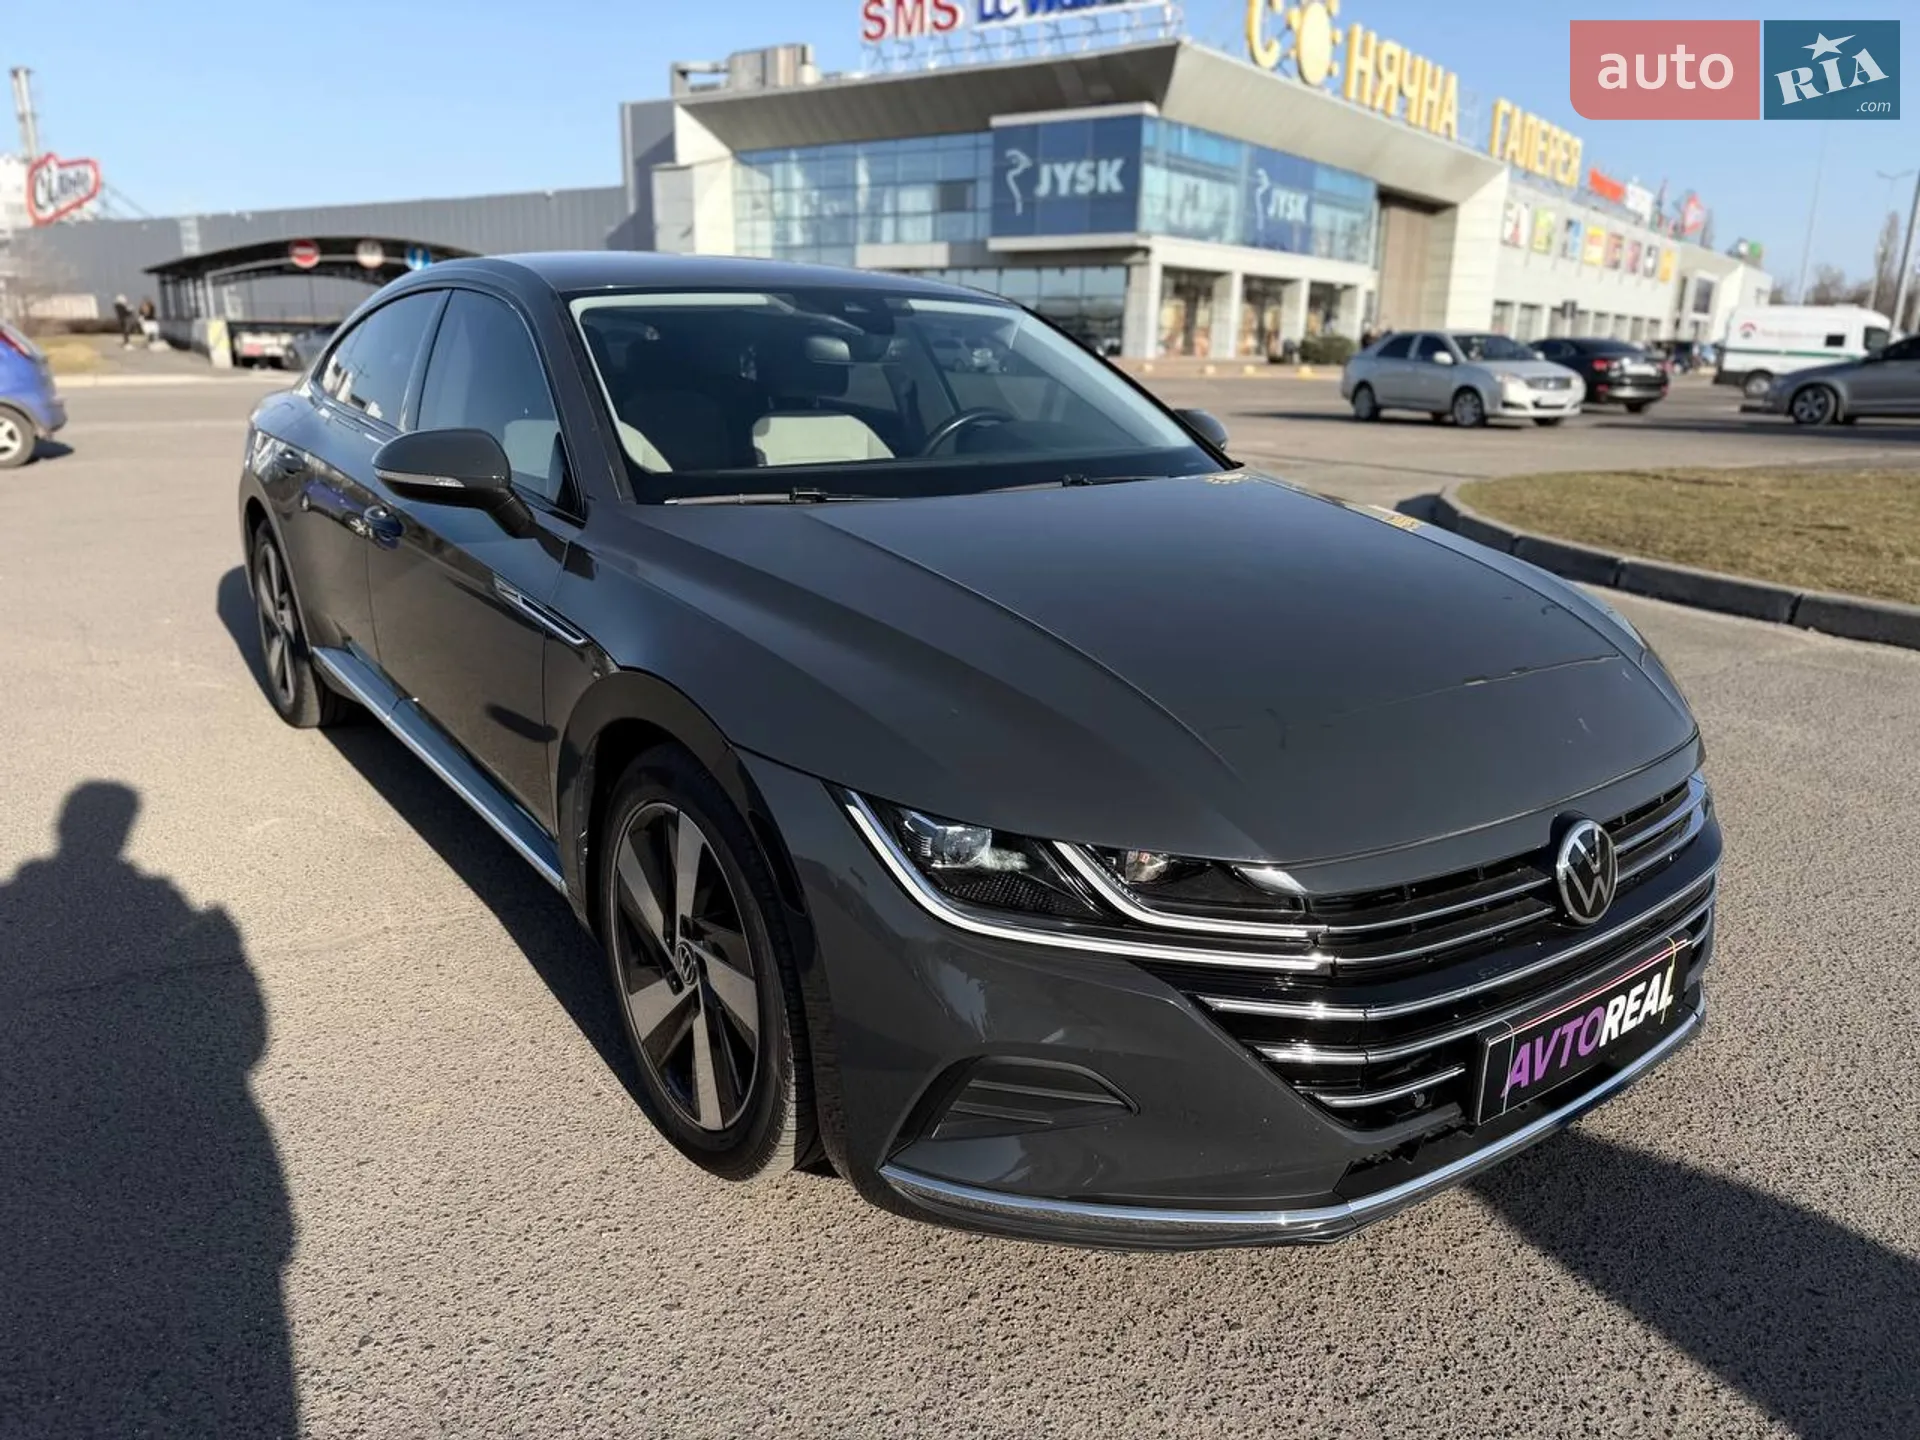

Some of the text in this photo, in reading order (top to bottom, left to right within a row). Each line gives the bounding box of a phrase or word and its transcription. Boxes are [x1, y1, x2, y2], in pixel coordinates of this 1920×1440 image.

[862, 0, 957, 41] SMS
[1489, 98, 1584, 187] ГАЛЕРЕЯ
[1034, 158, 1125, 197] JYSK
[1267, 188, 1309, 223] JYSK
[1501, 966, 1673, 1099] AVTOREAL
